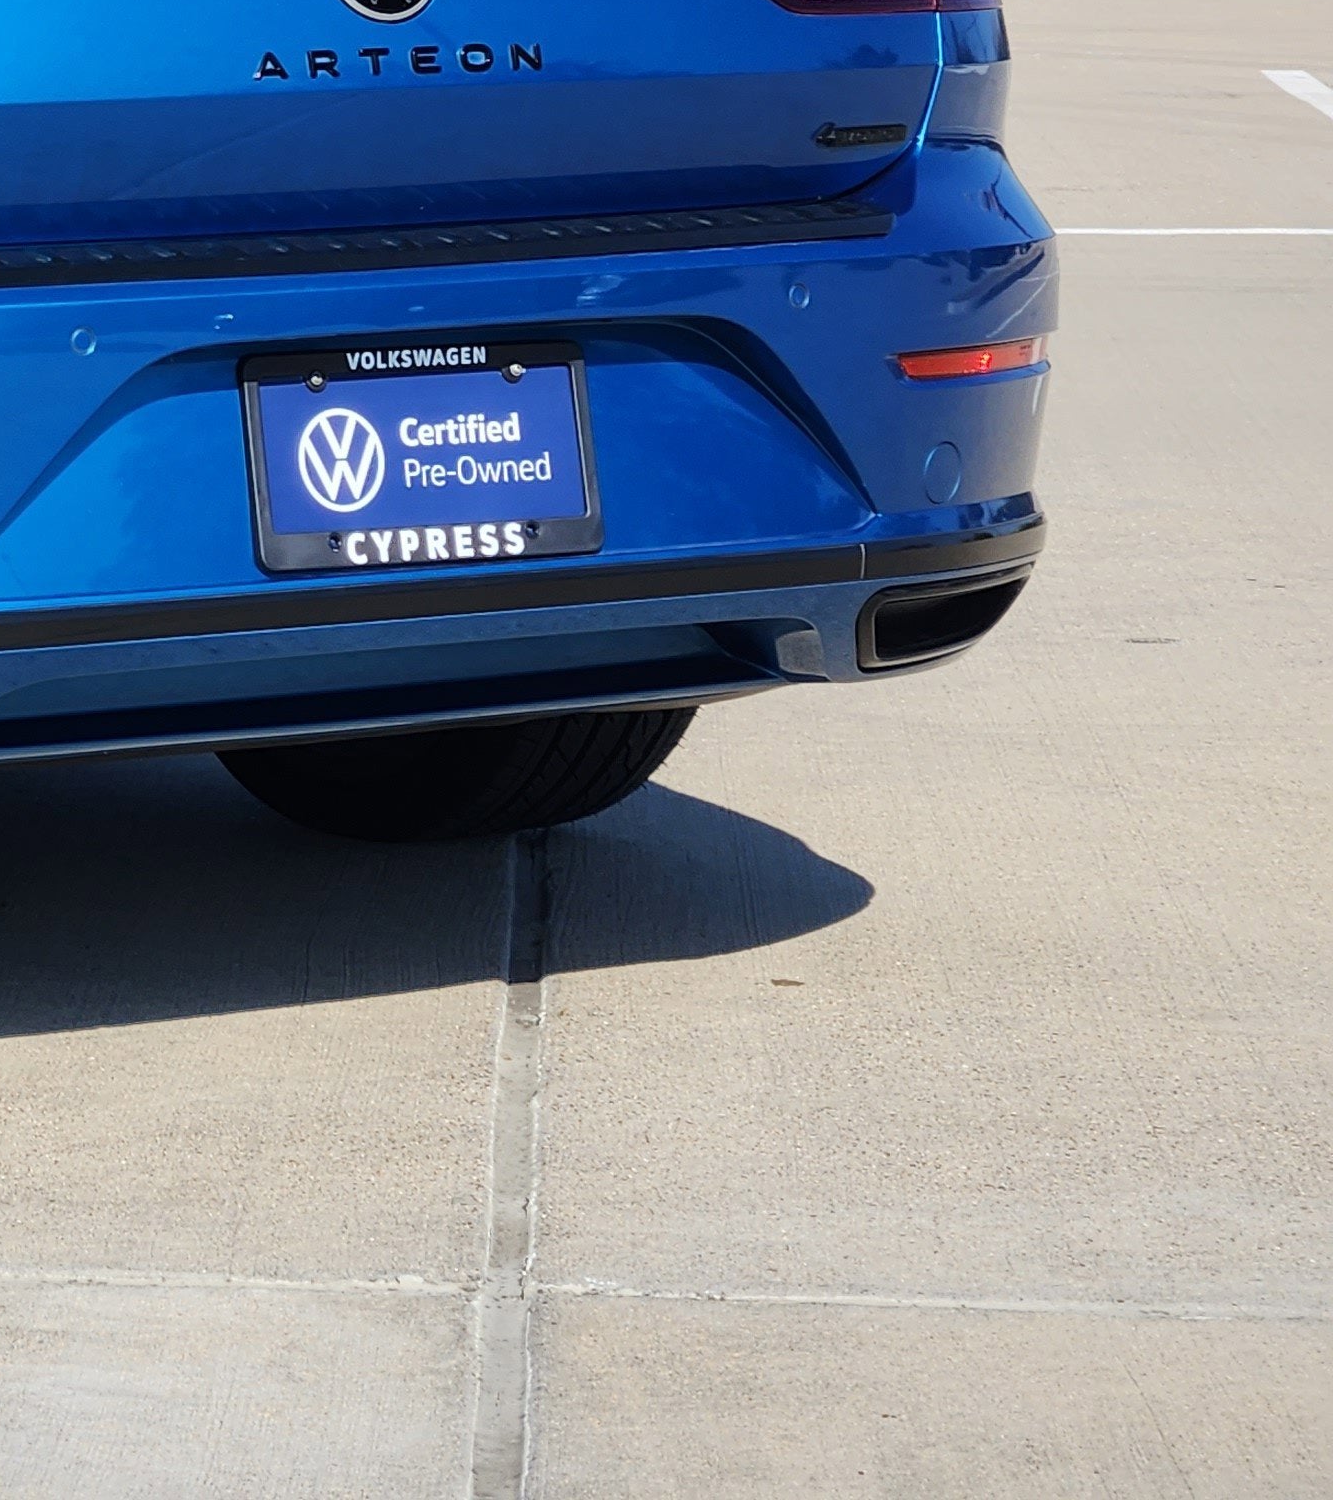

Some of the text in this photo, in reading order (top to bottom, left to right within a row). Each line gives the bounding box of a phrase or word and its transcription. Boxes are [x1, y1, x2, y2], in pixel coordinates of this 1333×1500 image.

[253, 43, 543, 81] ARTEON
[346, 346, 486, 370] VOLKSWAGEN
[399, 412, 521, 447] Certified
[299, 408, 385, 512] VW
[403, 451, 552, 488] Pre-Owned
[346, 522, 525, 565] CYPRESS
